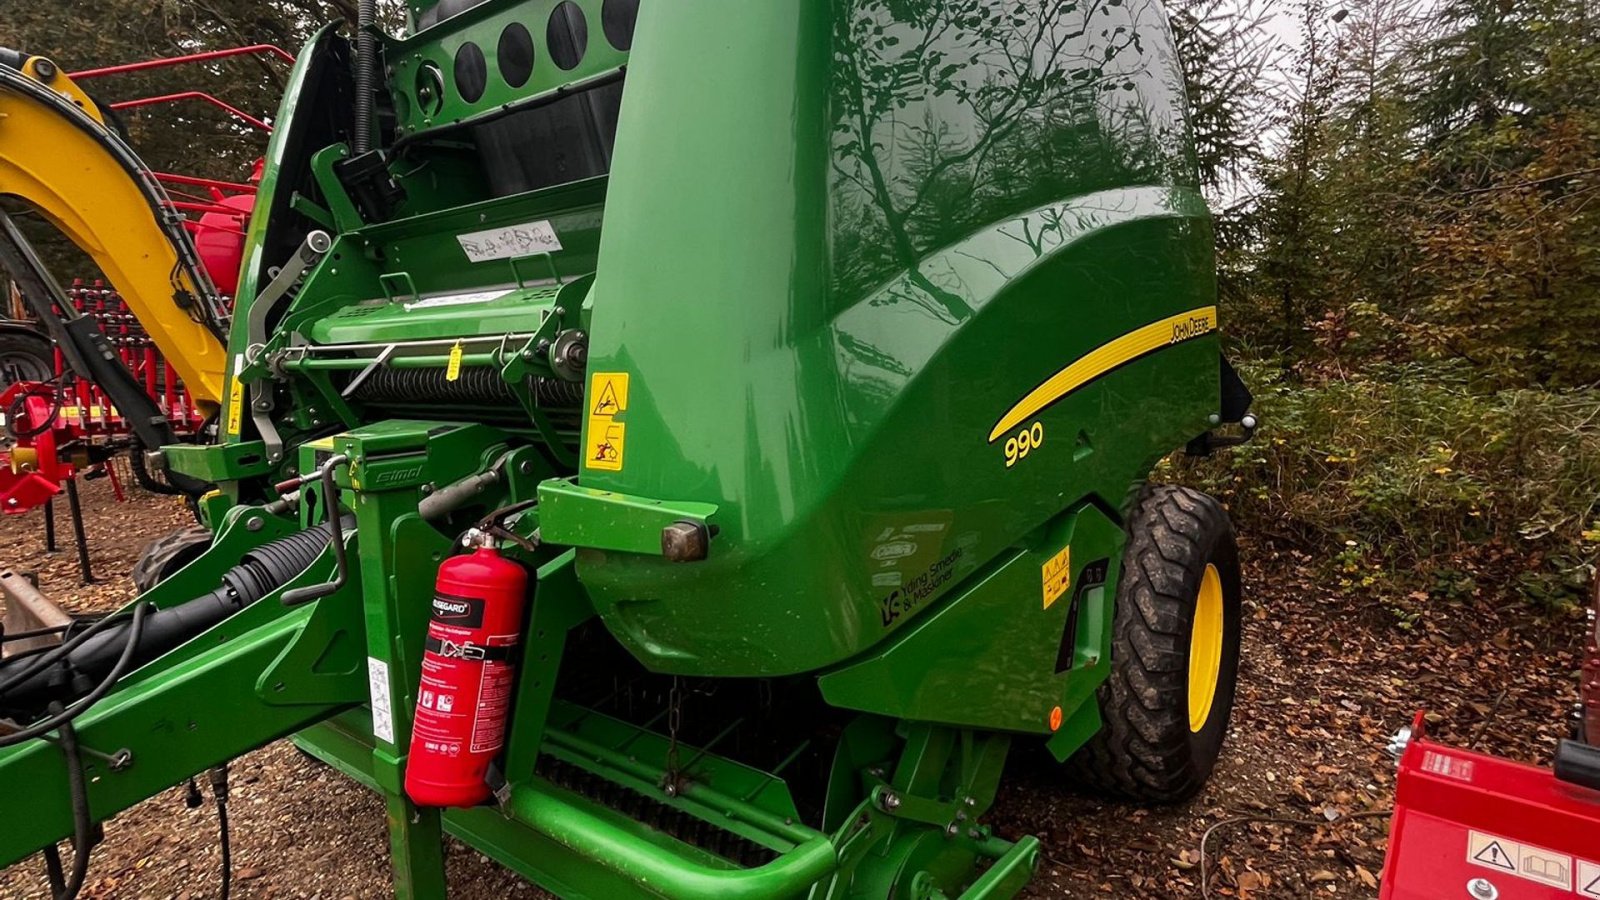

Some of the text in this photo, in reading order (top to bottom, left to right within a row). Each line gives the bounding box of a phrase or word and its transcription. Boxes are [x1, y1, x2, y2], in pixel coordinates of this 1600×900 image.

[1170, 317, 1210, 344] JOHN DEERE
[1004, 421, 1043, 467] 990
[900, 573, 928, 597] Yding
[902, 599, 912, 612] &
[913, 569, 953, 604] Maskiner
